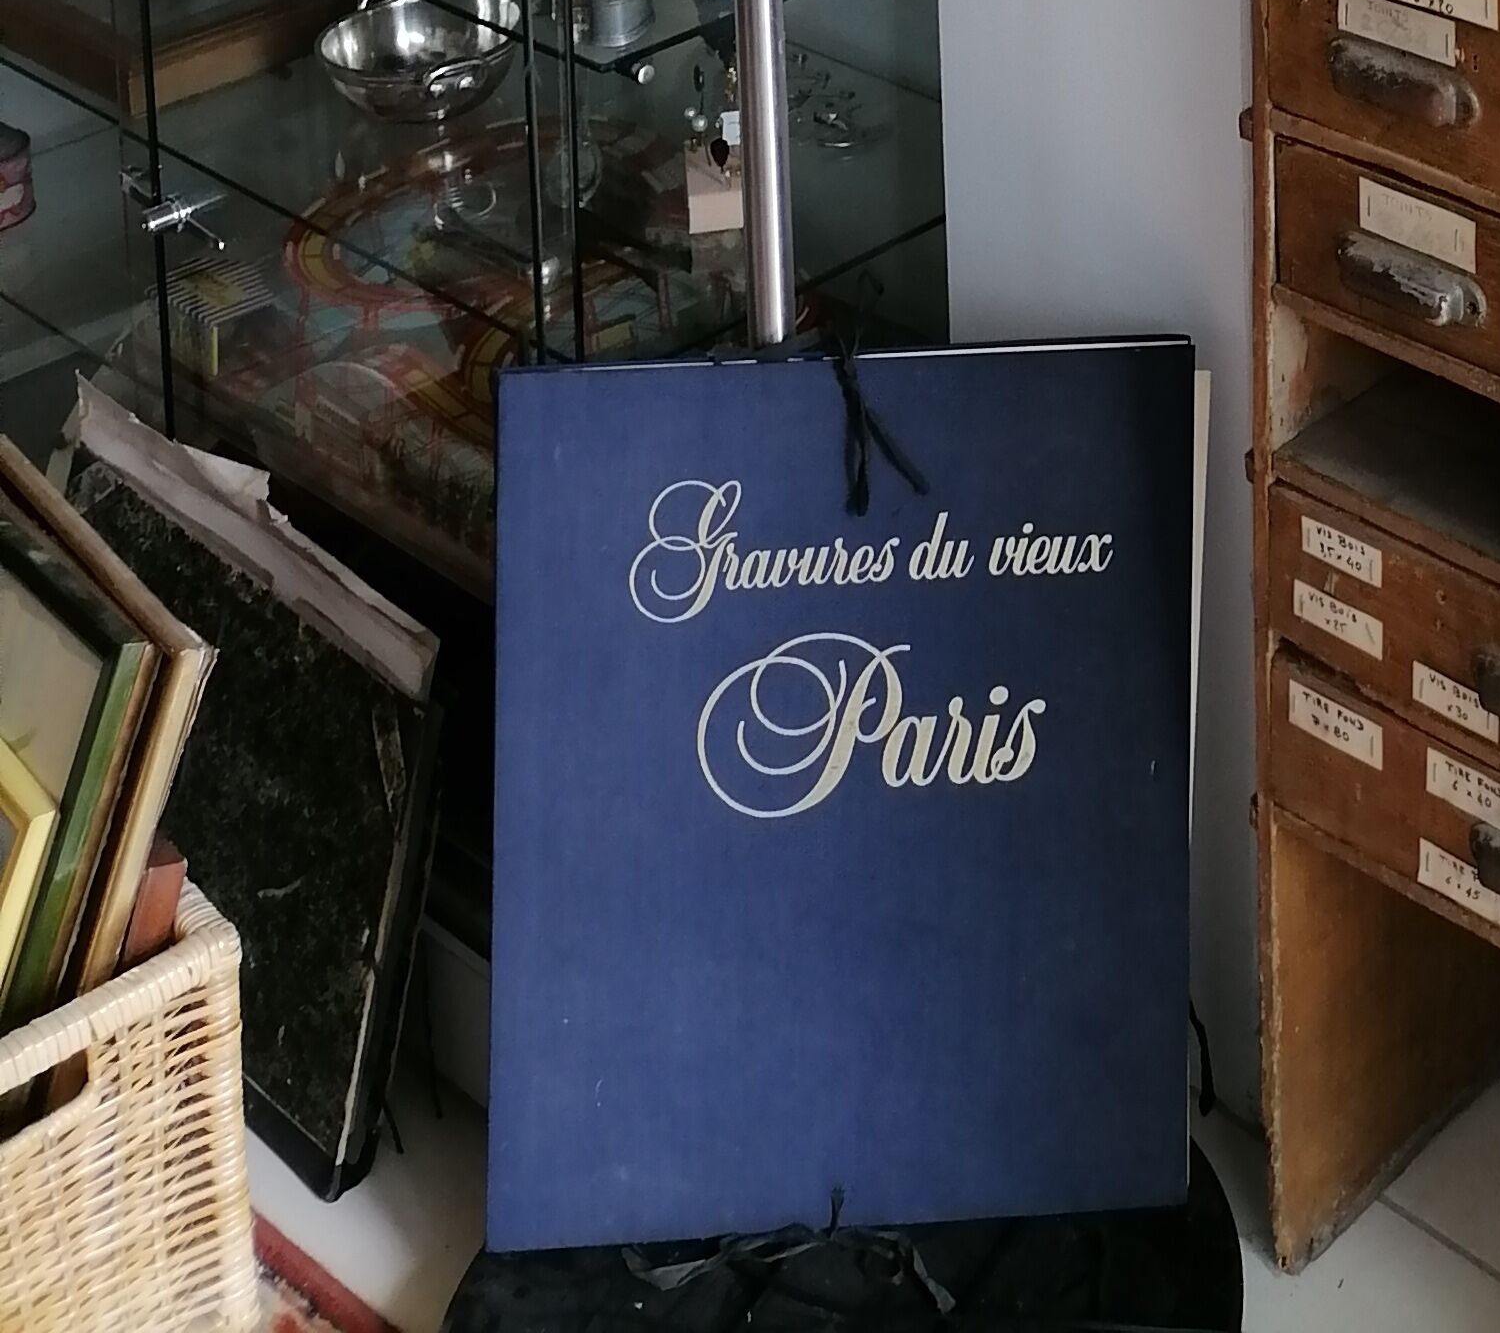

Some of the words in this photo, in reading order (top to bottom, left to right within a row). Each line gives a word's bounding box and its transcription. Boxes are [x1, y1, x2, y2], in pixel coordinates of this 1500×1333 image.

[1316, 525, 1332, 540] VIS
[629, 480, 900, 623] Gravures
[908, 512, 974, 581] du
[988, 522, 1114, 577] vieux
[1308, 589, 1325, 608] VIS
[1429, 672, 1447, 692] VIS
[1455, 705, 1468, 722] 30
[697, 632, 1047, 818] Paris
